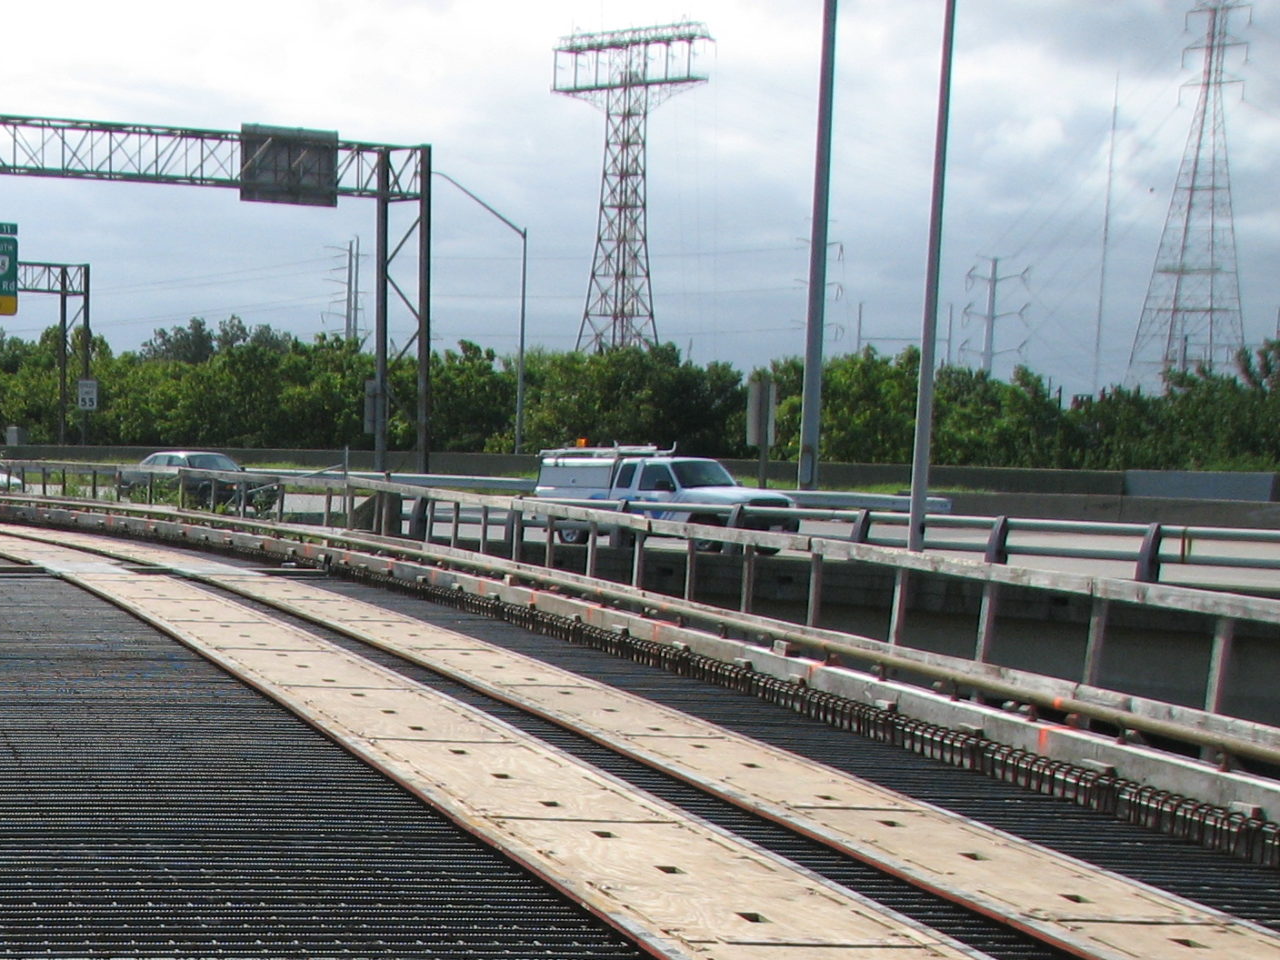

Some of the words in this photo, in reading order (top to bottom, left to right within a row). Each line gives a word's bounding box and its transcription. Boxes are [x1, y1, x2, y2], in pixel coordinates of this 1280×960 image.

[2, 225, 11, 233] 11
[2, 278, 15, 291] Rd
[81, 397, 95, 407] 55
